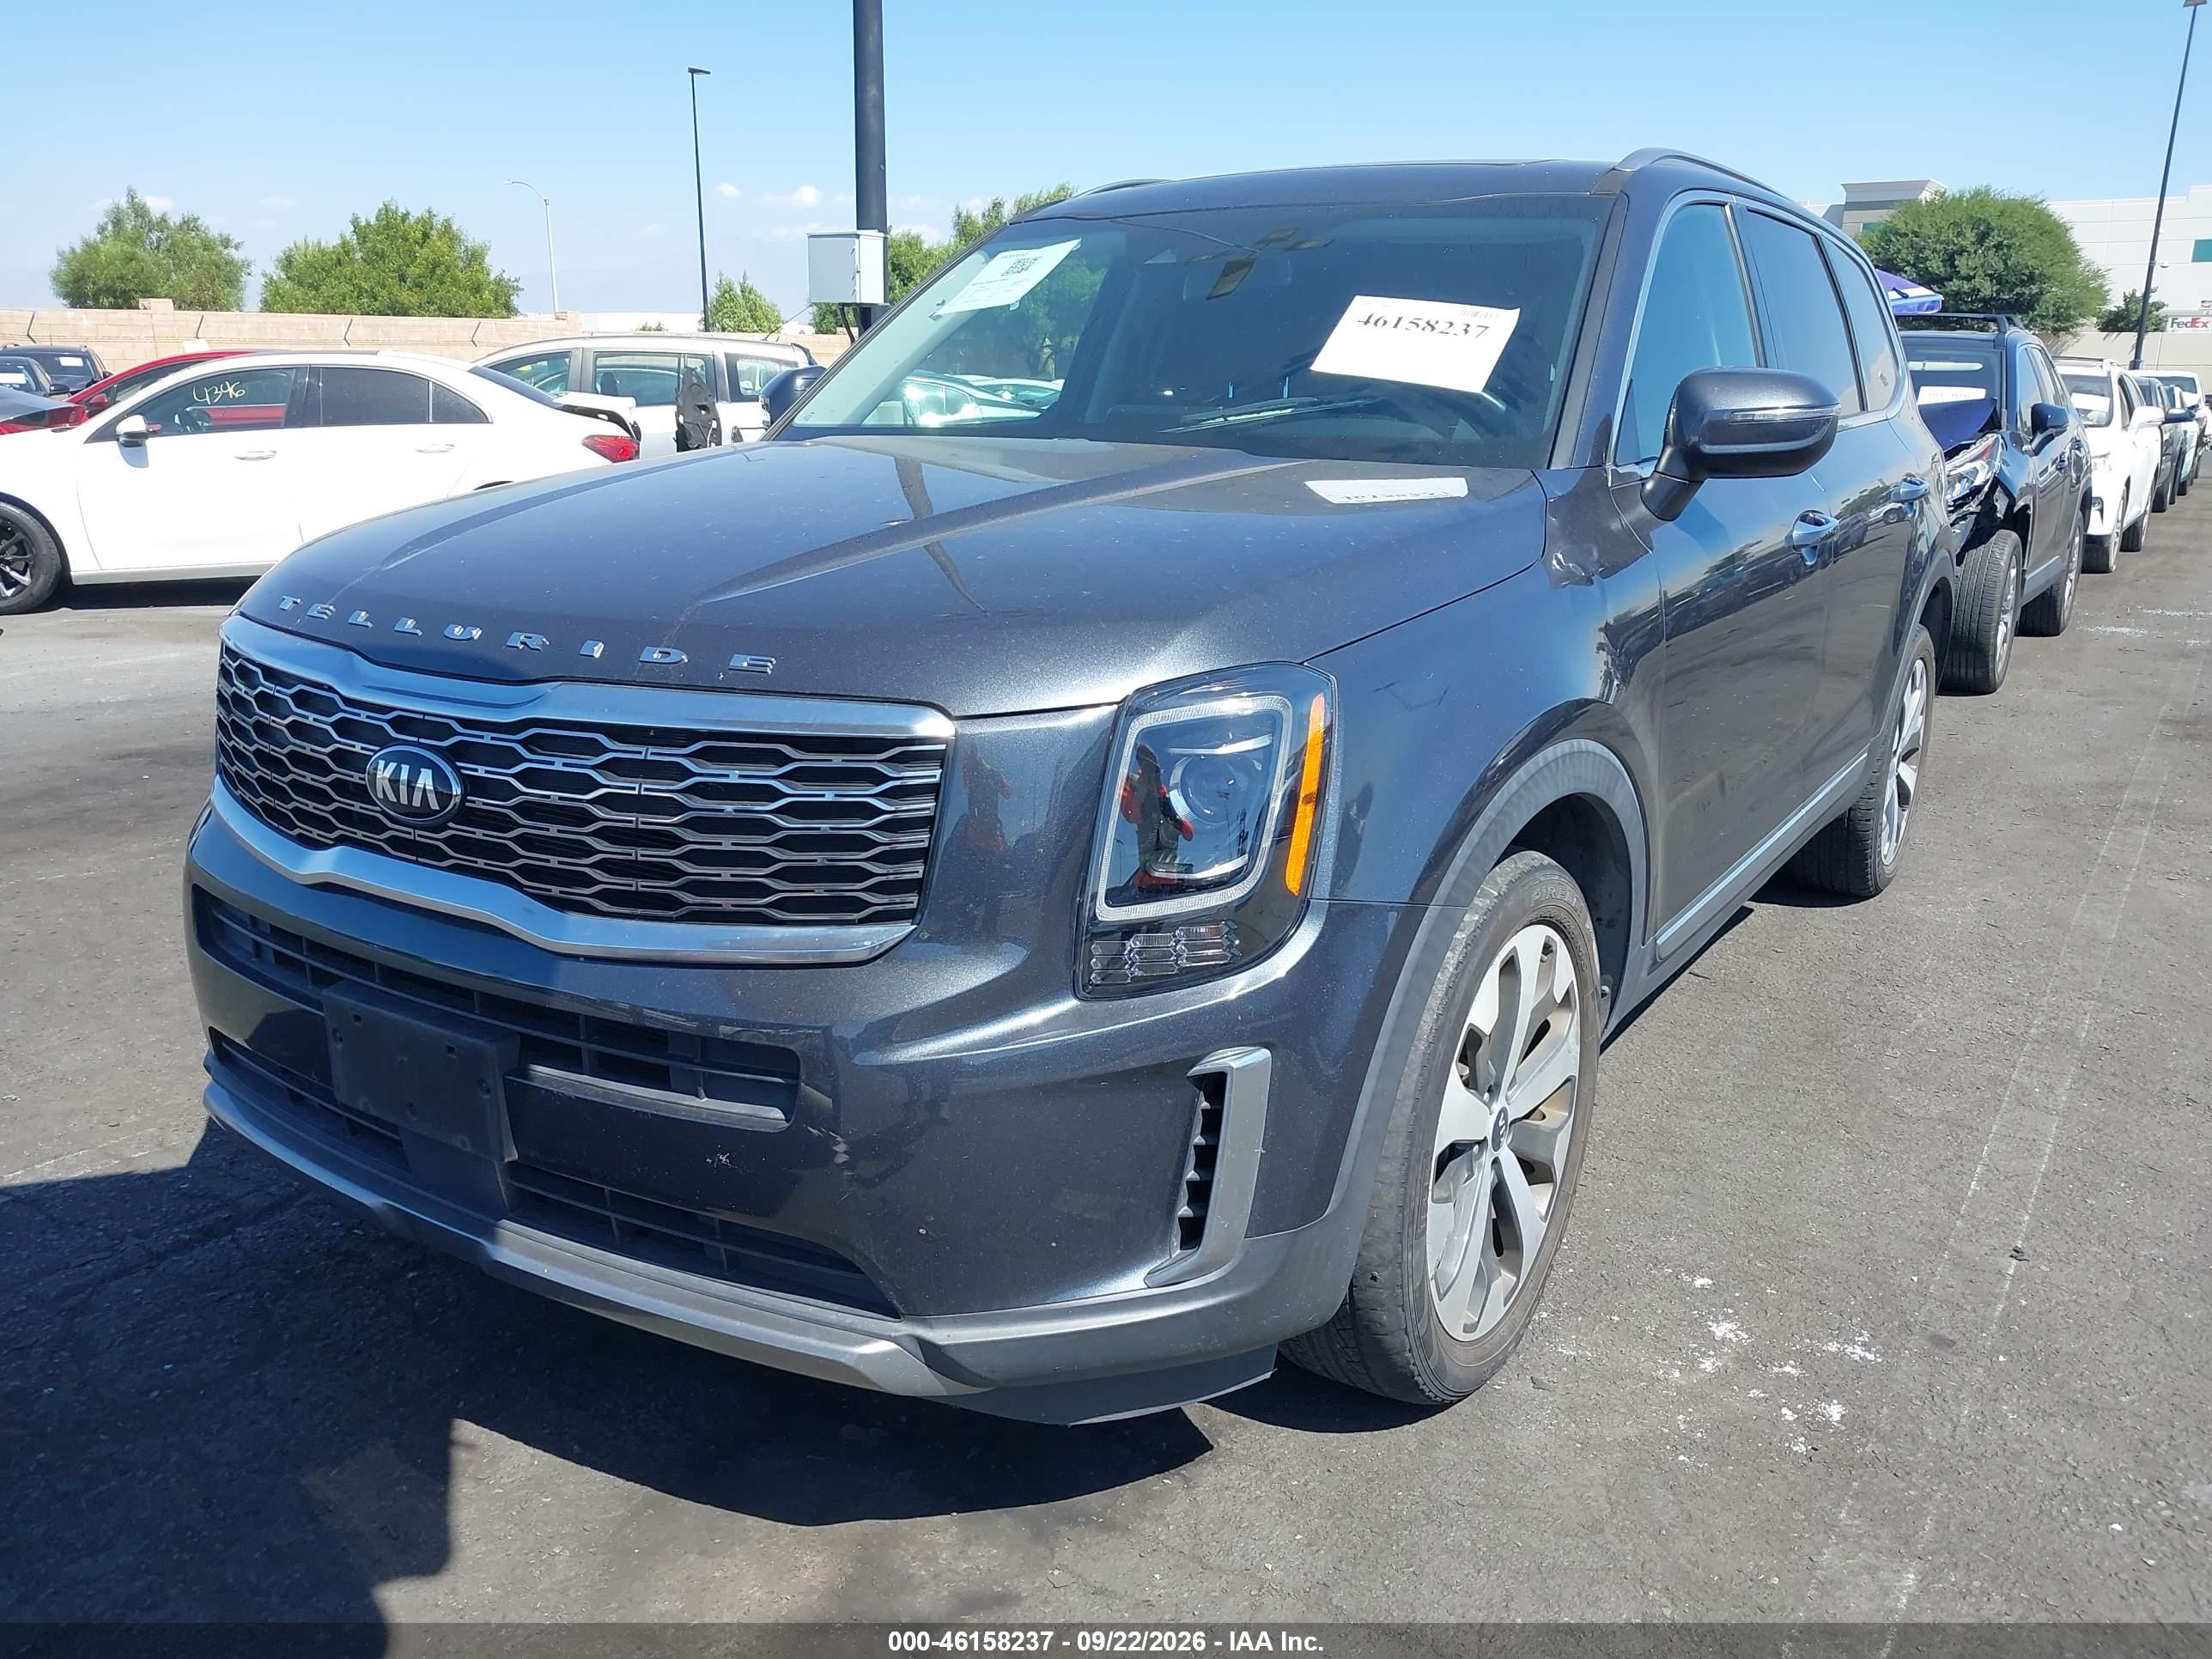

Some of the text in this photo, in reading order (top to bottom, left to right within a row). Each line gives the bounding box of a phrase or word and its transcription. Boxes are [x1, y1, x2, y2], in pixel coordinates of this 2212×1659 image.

[1357, 313, 1491, 339] 46158237
[2170, 317, 2211, 328] FedEx
[192, 380, 246, 405] 4346
[278, 594, 778, 675] TELLURIDE
[376, 759, 441, 811] KIA
